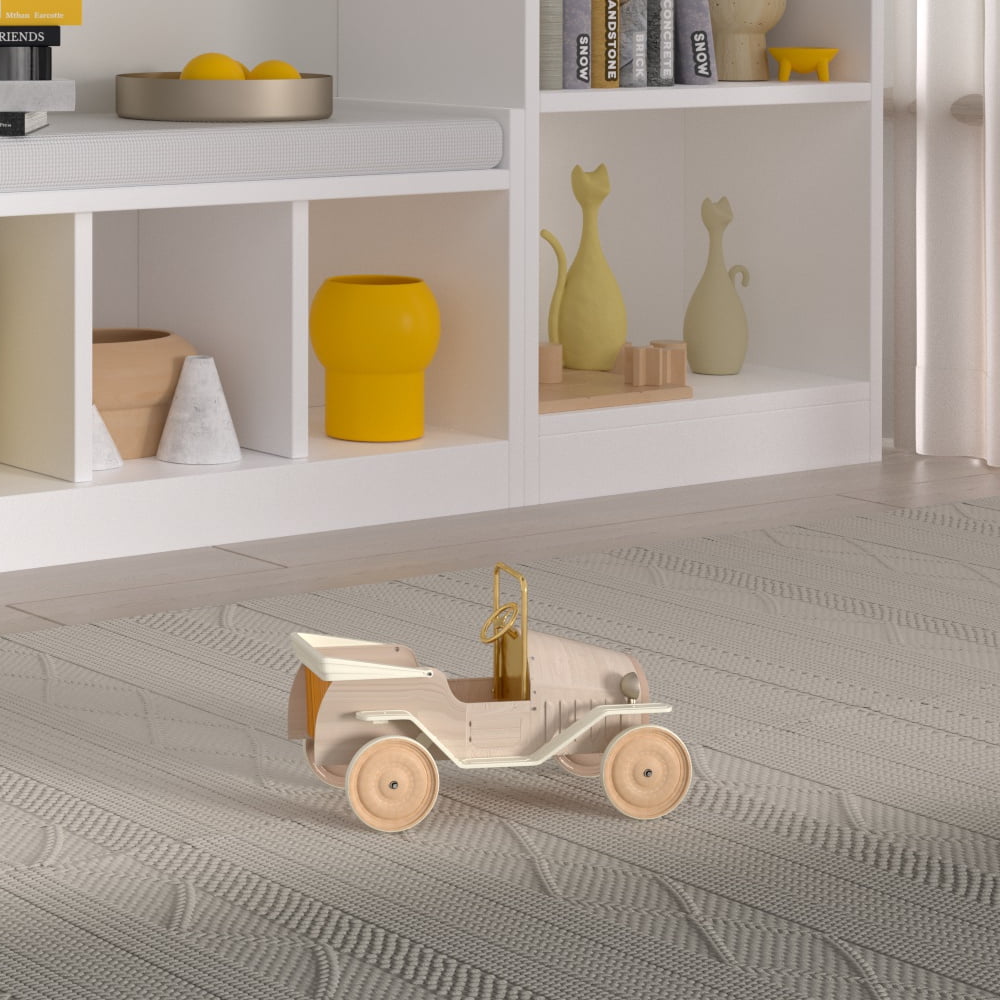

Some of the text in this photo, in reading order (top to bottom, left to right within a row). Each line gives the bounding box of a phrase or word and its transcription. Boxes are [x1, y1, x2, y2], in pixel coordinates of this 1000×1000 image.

[579, 36, 589, 81] SNOW
[635, 34, 645, 77] BRICK
[693, 33, 709, 77] SNOW
